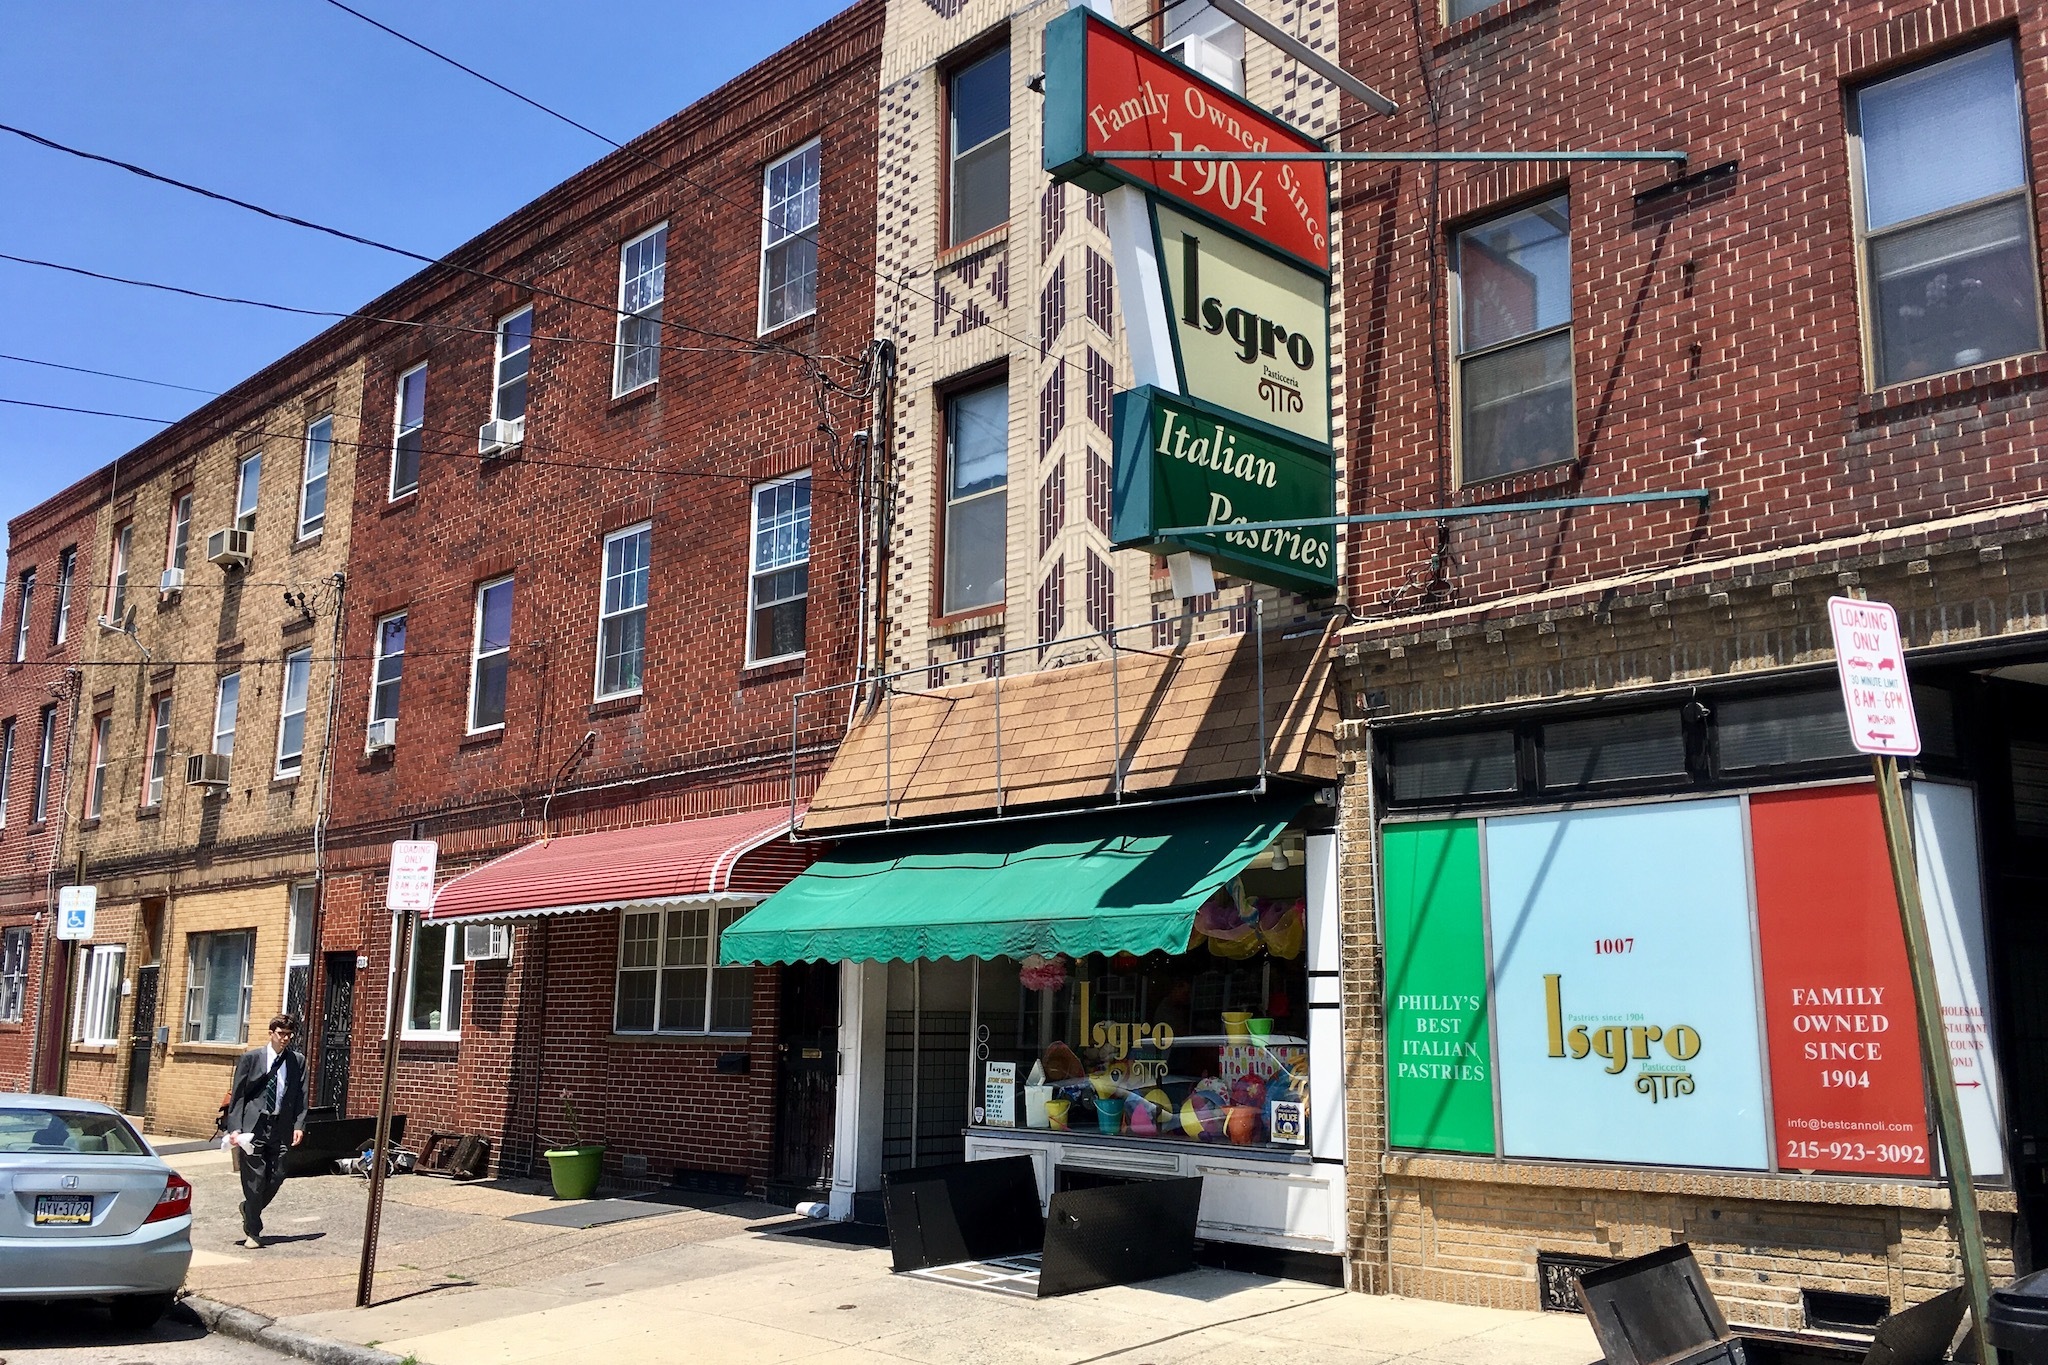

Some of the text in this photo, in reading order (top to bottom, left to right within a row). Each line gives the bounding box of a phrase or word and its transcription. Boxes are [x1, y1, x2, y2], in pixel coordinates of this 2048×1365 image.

[1089, 80, 1325, 250] Family Owned Since
[1169, 131, 1267, 226] 1904
[1181, 231, 1314, 370] Isgro
[1263, 365, 1299, 387] Pasticceria
[1156, 408, 1278, 489] Italian
[1205, 492, 1329, 568] Pastries
[1839, 608, 1887, 631] LOADING
[1853, 632, 1880, 651] ONLY
[1861, 676, 1882, 687] MINUTE
[1884, 678, 1898, 688] LIMIT
[399, 844, 431, 854] LOADING
[404, 855, 423, 864] ONLY
[1593, 938, 1635, 955] 1007
[1398, 994, 1480, 1011] PHILLY'S
[1792, 987, 1885, 1006] FAMILY
[1079, 981, 1174, 1060] Isgro
[1568, 1013, 1644, 1022] Pastries since 1904
[1941, 1006, 1984, 1017] HOLESALE
[1416, 1017, 1462, 1034] BEST
[1543, 974, 1701, 1074] Isgro
[1793, 1014, 1889, 1033] OWNED
[1944, 1023, 1987, 1033] STAURANT
[1402, 1040, 1478, 1057] ITALIAN
[1804, 1042, 1882, 1061] SINCE
[1642, 1063, 1686, 1072] Pasticceria
[1952, 1057, 1974, 1067] ONLY
[1397, 1062, 1485, 1081] PASTRIES
[1821, 1070, 1870, 1088] 1904
[1278, 1113, 1298, 1122] POLICE
[1787, 1118, 1913, 1132] info@bestcannoli.com
[1787, 1140, 1925, 1164] 215-923-3092
